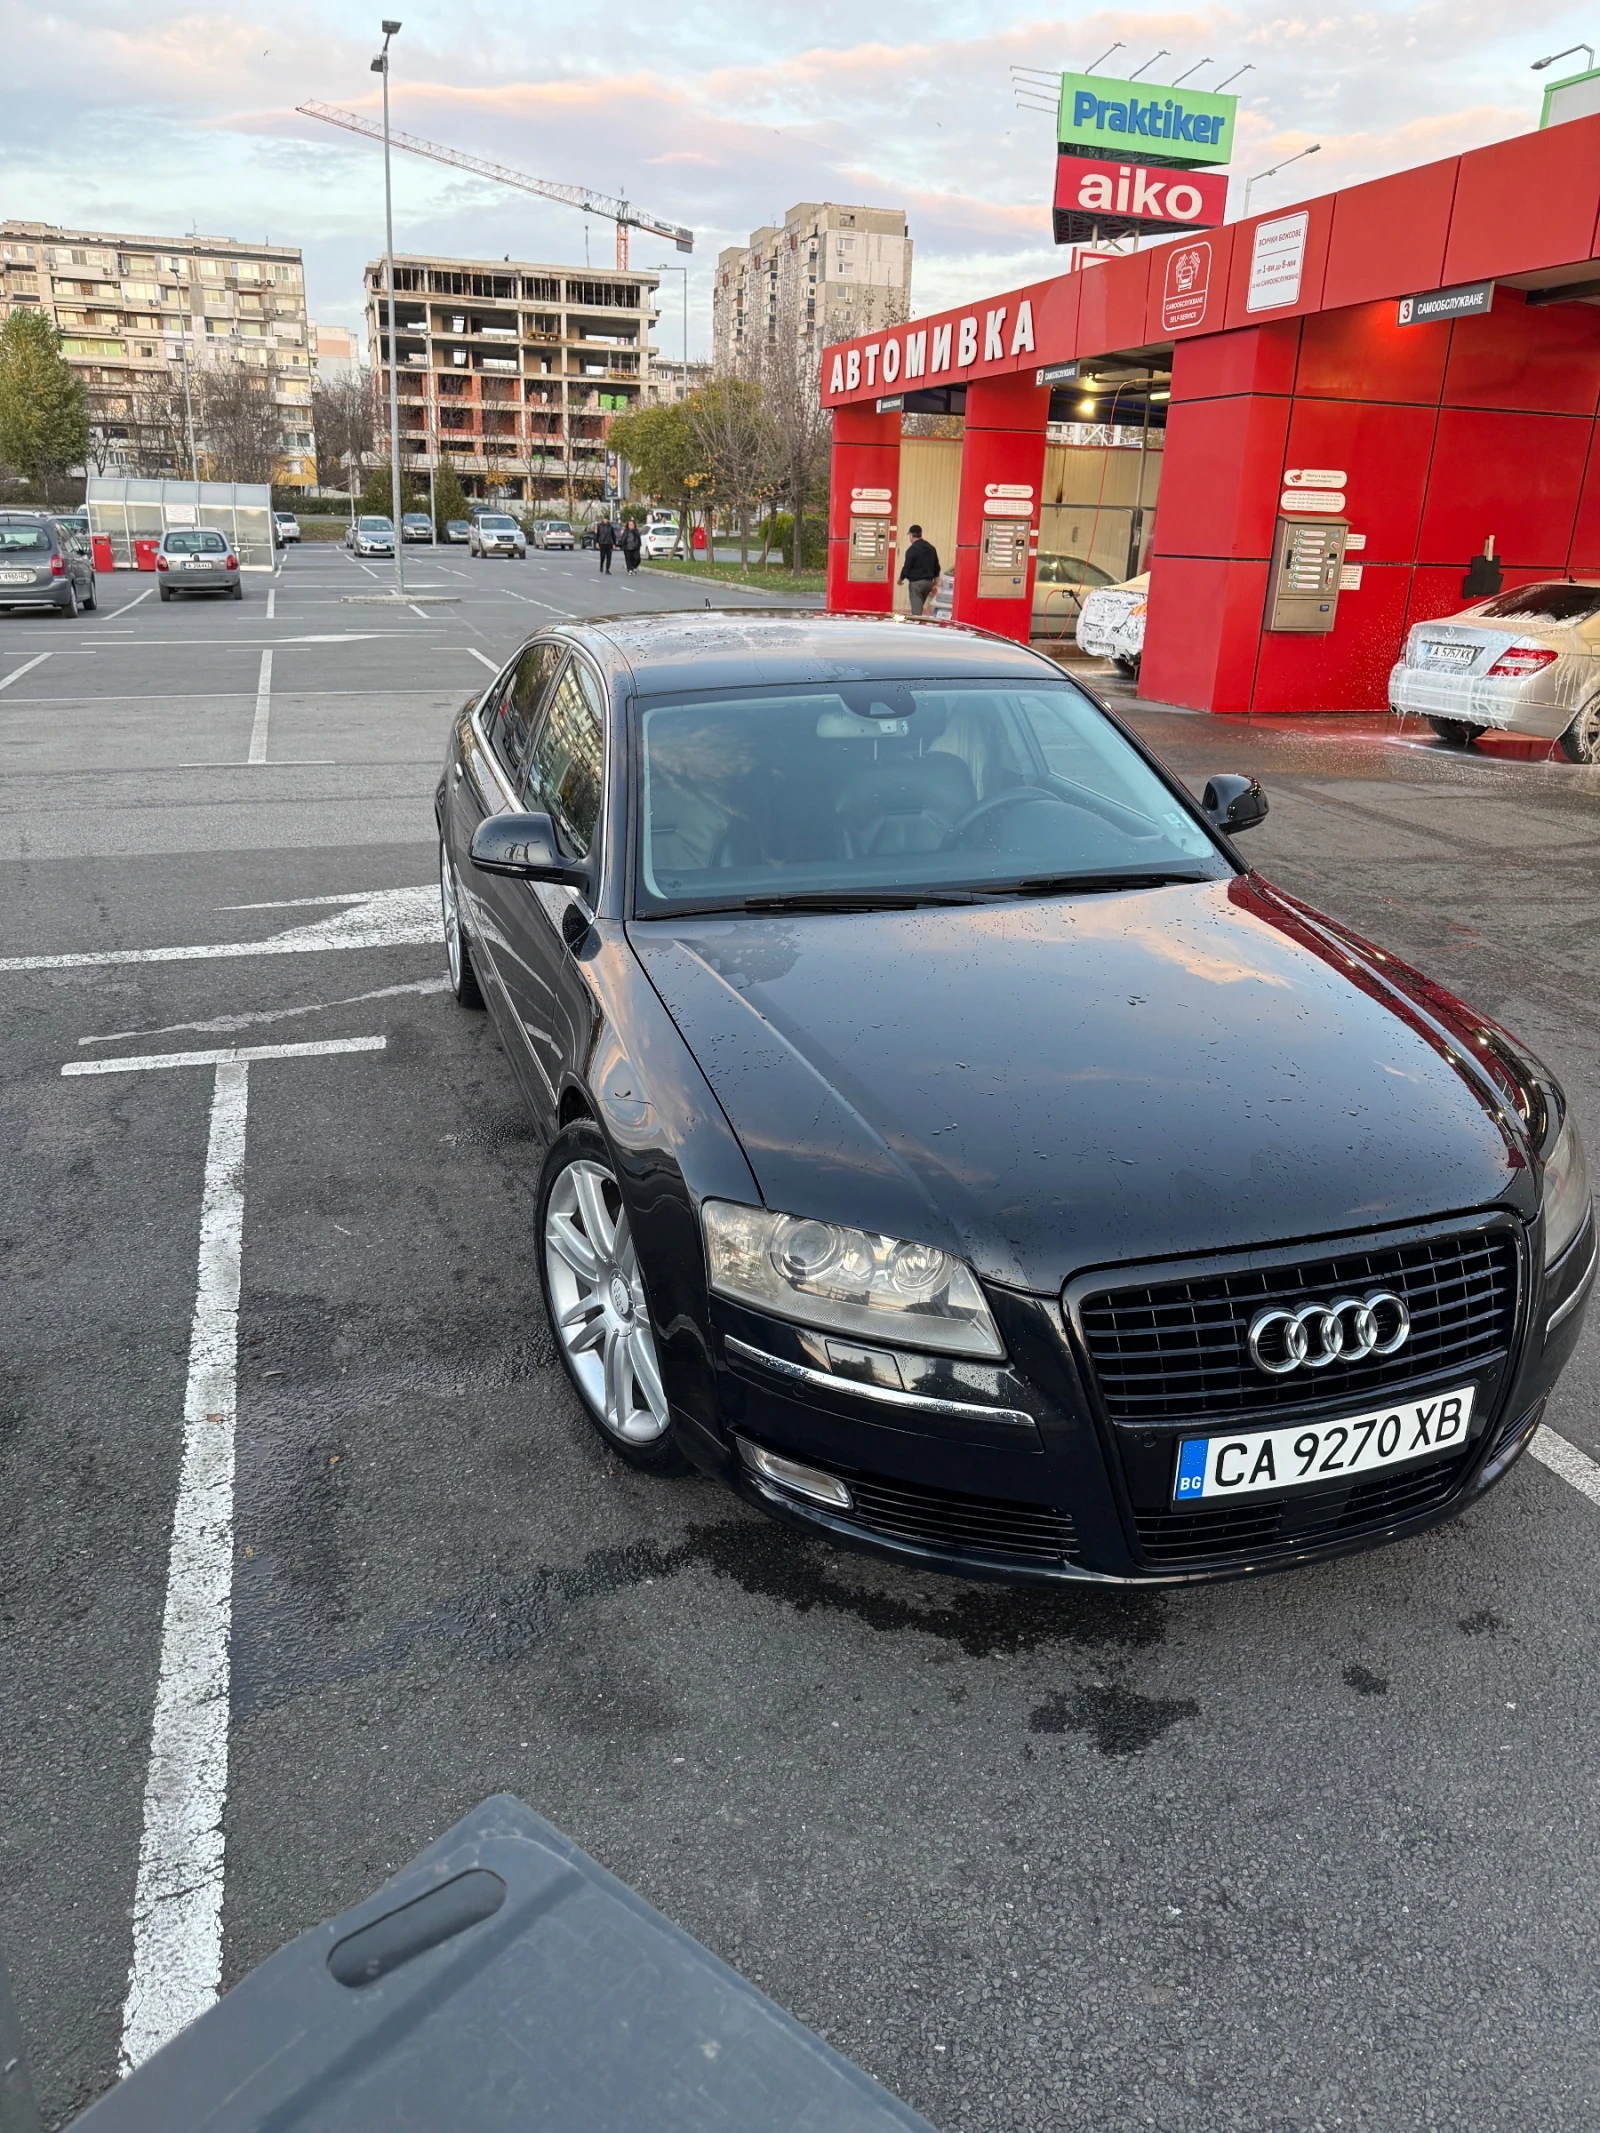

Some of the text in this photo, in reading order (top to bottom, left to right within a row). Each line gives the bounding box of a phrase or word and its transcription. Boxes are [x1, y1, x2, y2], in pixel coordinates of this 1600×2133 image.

[1073, 90, 1225, 145] Praktiker
[1077, 165, 1203, 220] aiko
[1258, 228, 1302, 247] ВСИЧКИ БОКСОВЕ
[1262, 263, 1275, 274] 1-ви
[1275, 264, 1281, 272] до
[1403, 292, 1484, 319] 3 САМООБСЛУЖВАНЕ
[1169, 311, 1197, 324] SELF-SERVICE
[829, 300, 1036, 395] АВТОМИВКА
[1037, 371, 1043, 383] 2
[1433, 647, 1439, 656] A
[1441, 647, 1461, 658] 5757
[1214, 1397, 1463, 1488] CA 9270 XB
[1180, 1475, 1202, 1491] BG
